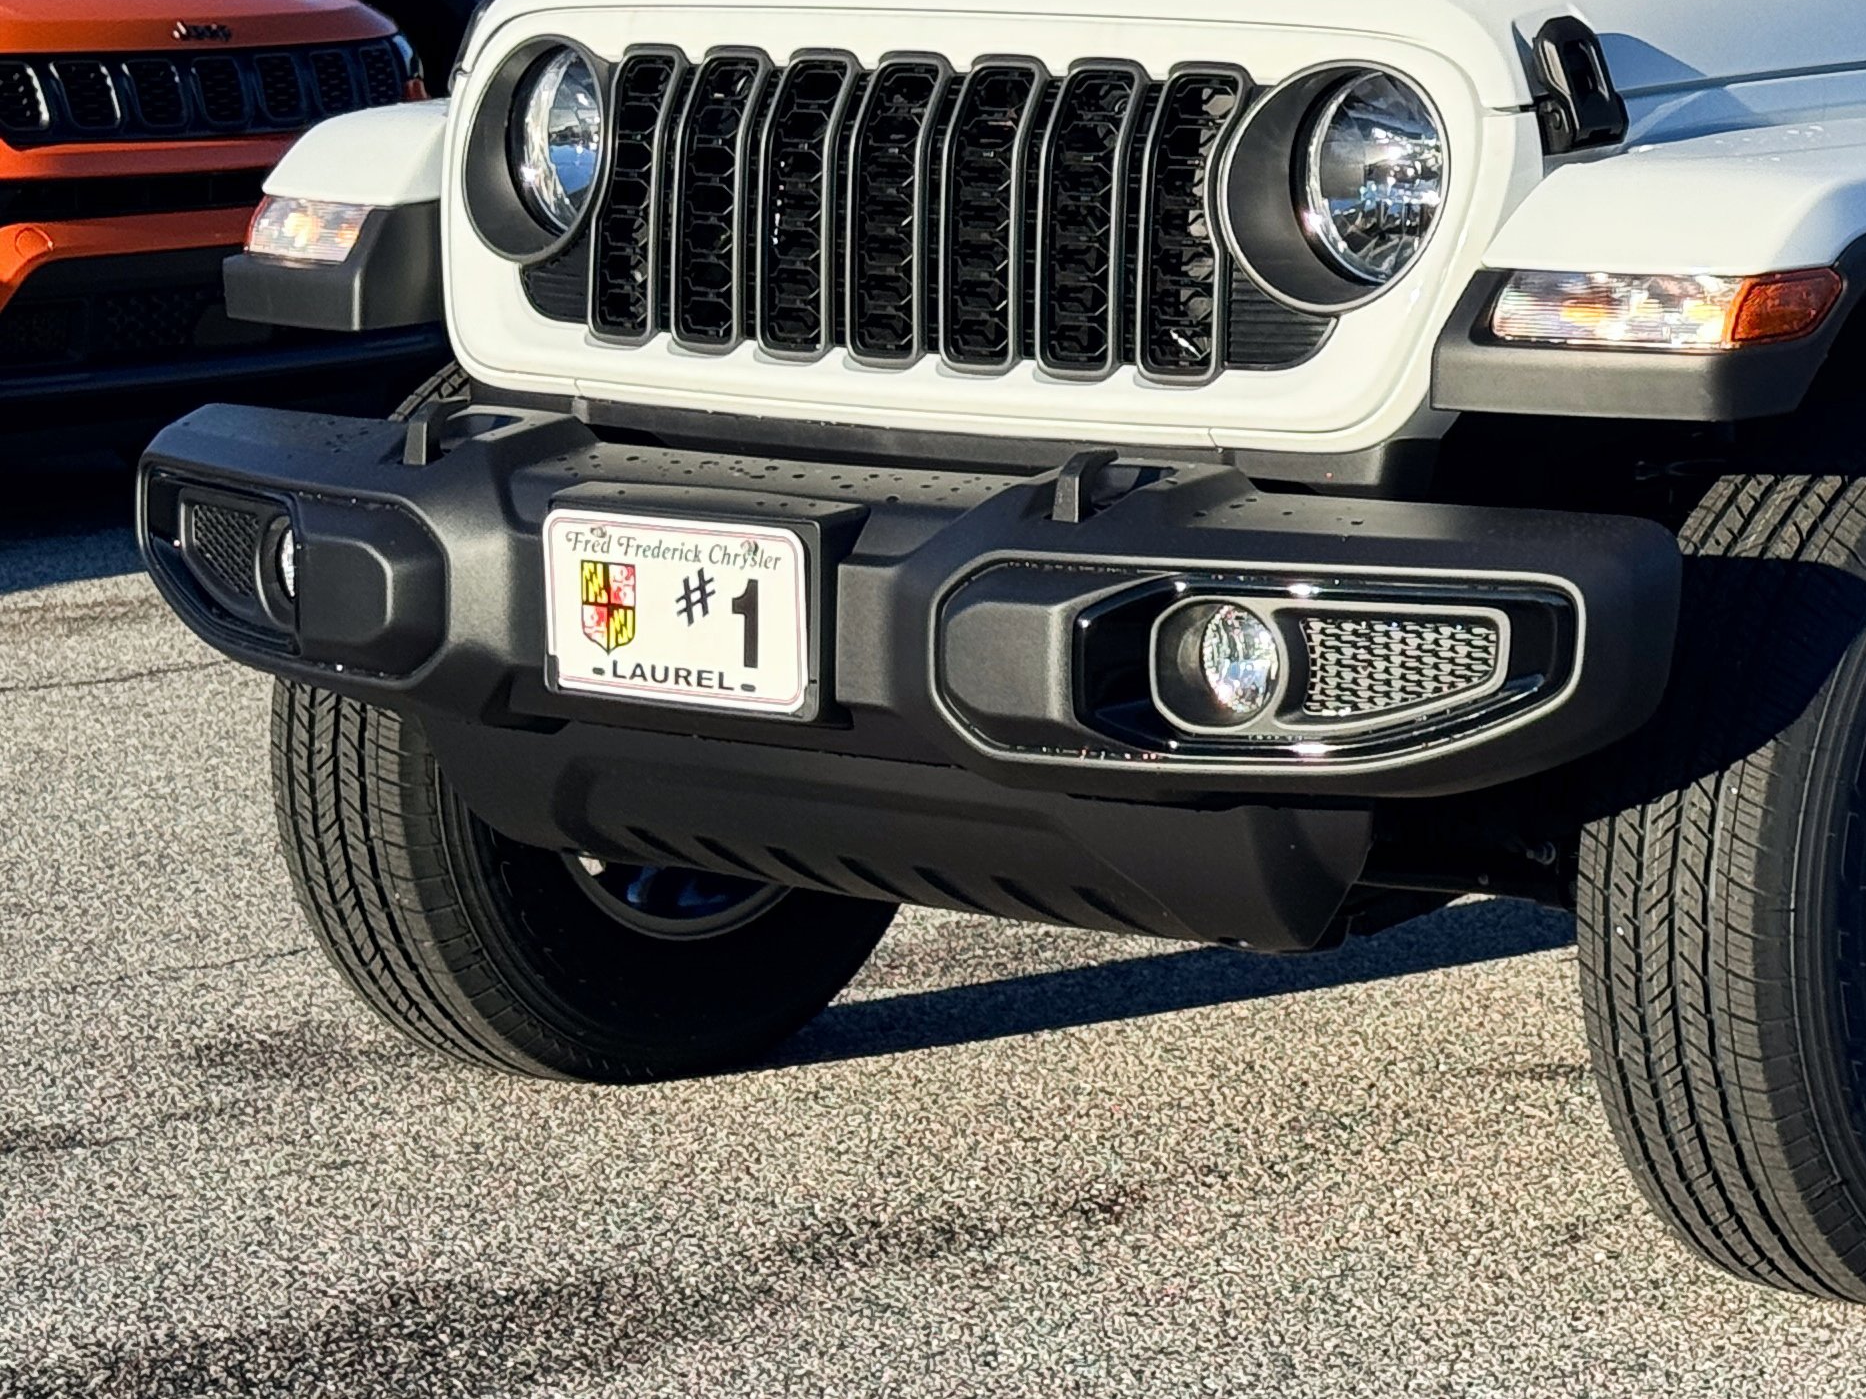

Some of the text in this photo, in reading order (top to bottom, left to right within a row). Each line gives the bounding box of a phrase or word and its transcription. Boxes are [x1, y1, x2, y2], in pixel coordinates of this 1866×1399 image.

[565, 530, 782, 571] Fred Frederick Chrysler
[611, 659, 735, 692] LAUREL
